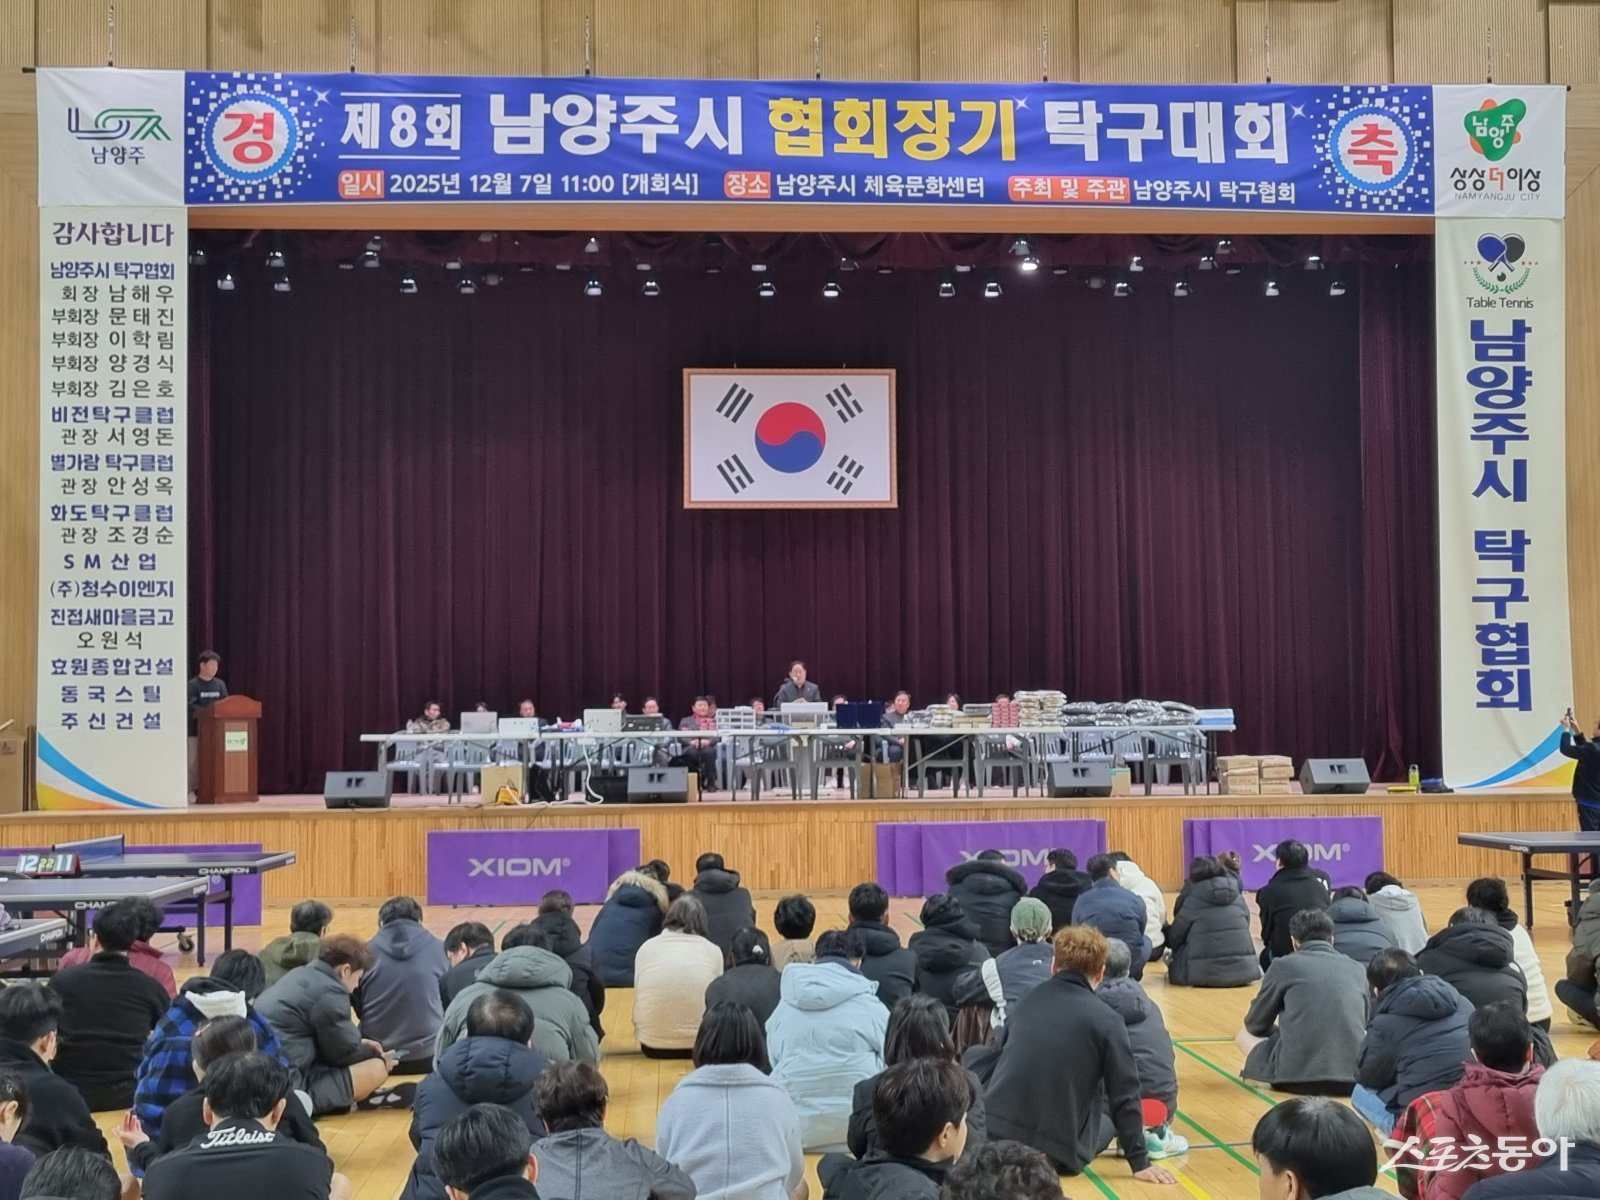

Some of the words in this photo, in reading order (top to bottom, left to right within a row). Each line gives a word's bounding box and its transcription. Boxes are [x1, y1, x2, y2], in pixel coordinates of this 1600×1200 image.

[222, 111, 275, 165] 경
[339, 101, 462, 150] 제8회
[489, 93, 743, 155] 남양주시
[767, 97, 1017, 161] 협회장기
[1044, 100, 1290, 165] 탁구대회
[1472, 113, 1515, 149] 남양주
[91, 146, 146, 166] 남양주
[1347, 123, 1399, 177] 축
[341, 172, 382, 196] 일시
[389, 172, 461, 196] 2025년
[470, 172, 511, 196] 12월
[519, 172, 552, 196] 7일
[561, 174, 615, 194] 11:00
[622, 172, 700, 196] [개회식]
[727, 173, 770, 196] 장소
[776, 173, 857, 197] 남양주시
[864, 174, 985, 199] 체육문화센터
[1012, 177, 1053, 200] 주최
[1060, 178, 1080, 200] 및
[1086, 178, 1128, 201] 주관
[1133, 180, 1212, 202] 남양주시
[1219, 181, 1296, 204] 탁구협회
[1455, 192, 1515, 201] NAMYANGJU
[1520, 193, 1541, 201] CITY
[52, 221, 175, 247] 감사합니다
[51, 261, 110, 279] 남양주시
[114, 262, 175, 280] 탁구협회
[1466, 297, 1497, 309] Table
[1499, 297, 1534, 309] Tennis
[51, 308, 100, 326] 부회장
[51, 331, 100, 349] 부회장
[51, 355, 100, 373] 부회장
[51, 380, 99, 398] 부회장
[1466, 319, 1533, 502] 남양주시
[61, 428, 99, 446] 관장
[51, 454, 101, 472] 별가람
[105, 454, 174, 472] 탁구클럽
[61, 478, 98, 495] 관장
[61, 527, 99, 545] 관장
[50, 580, 174, 599] (주)청수이엔지
[50, 608, 174, 626] 진접새마을금고
[1472, 529, 1533, 711] 탁구협회
[51, 658, 174, 676] 효원종합건설
[16, 855, 39, 873] 12
[54, 854, 73, 872] 11
[199, 867, 249, 875] CHAMPION
[200, 1126, 276, 1149] Titleist
